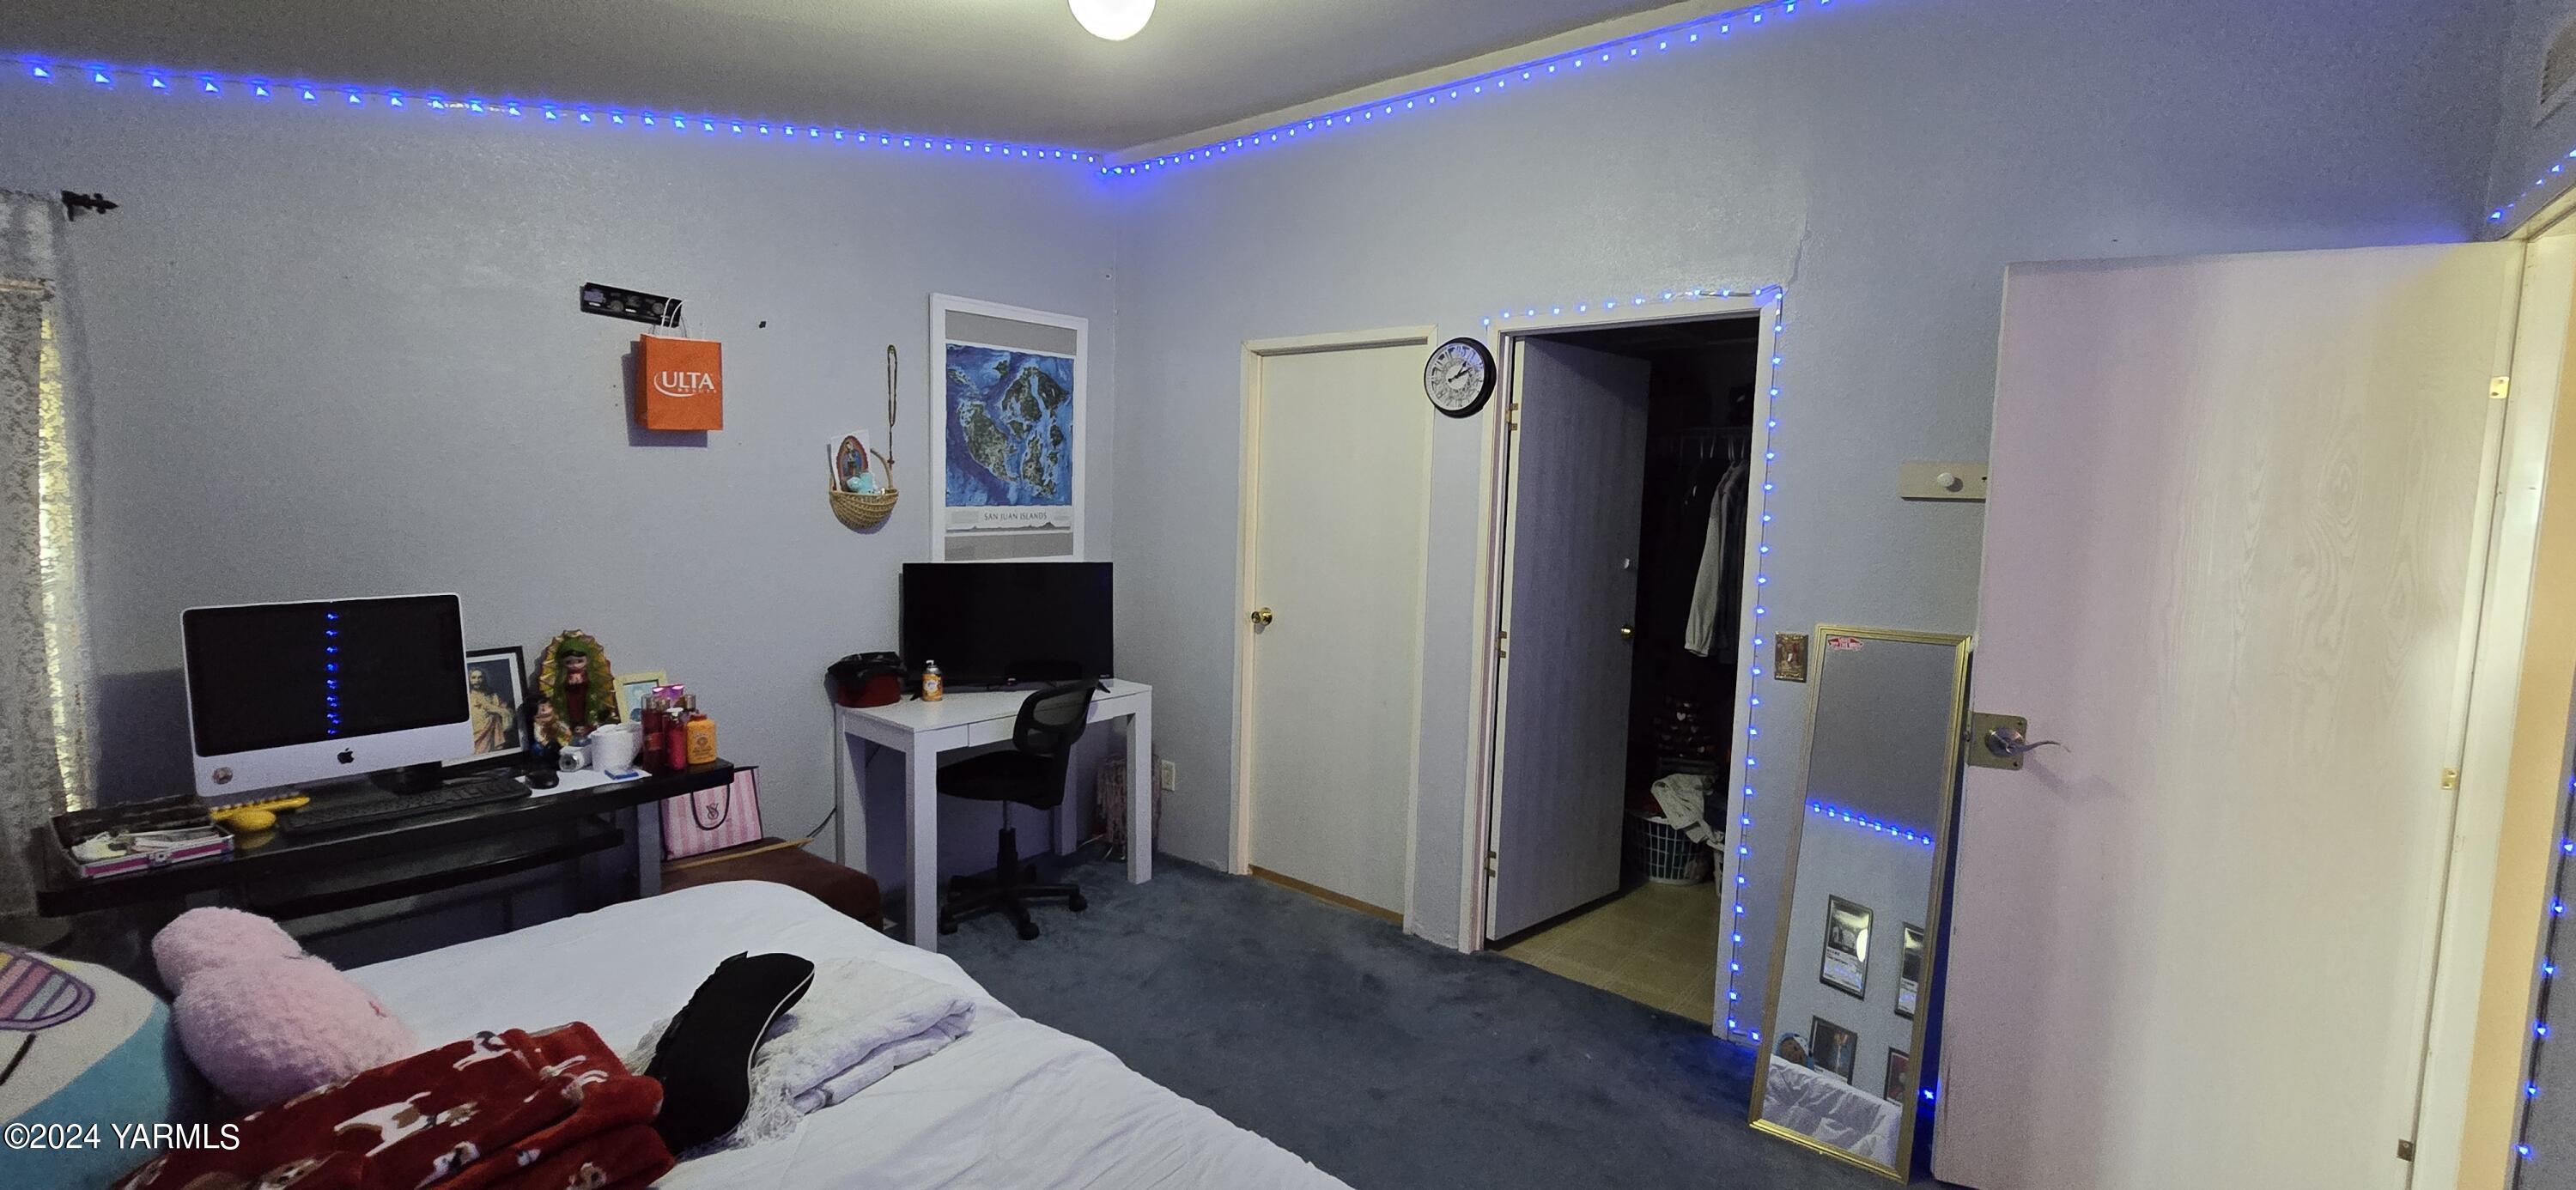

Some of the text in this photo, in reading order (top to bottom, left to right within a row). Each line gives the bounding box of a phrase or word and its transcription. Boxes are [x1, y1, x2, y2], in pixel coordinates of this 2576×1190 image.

[662, 371, 714, 390] ULTA
[984, 513, 998, 521] SAN
[1000, 513, 1018, 521] JUAN
[1020, 512, 1047, 520] ISLANDS
